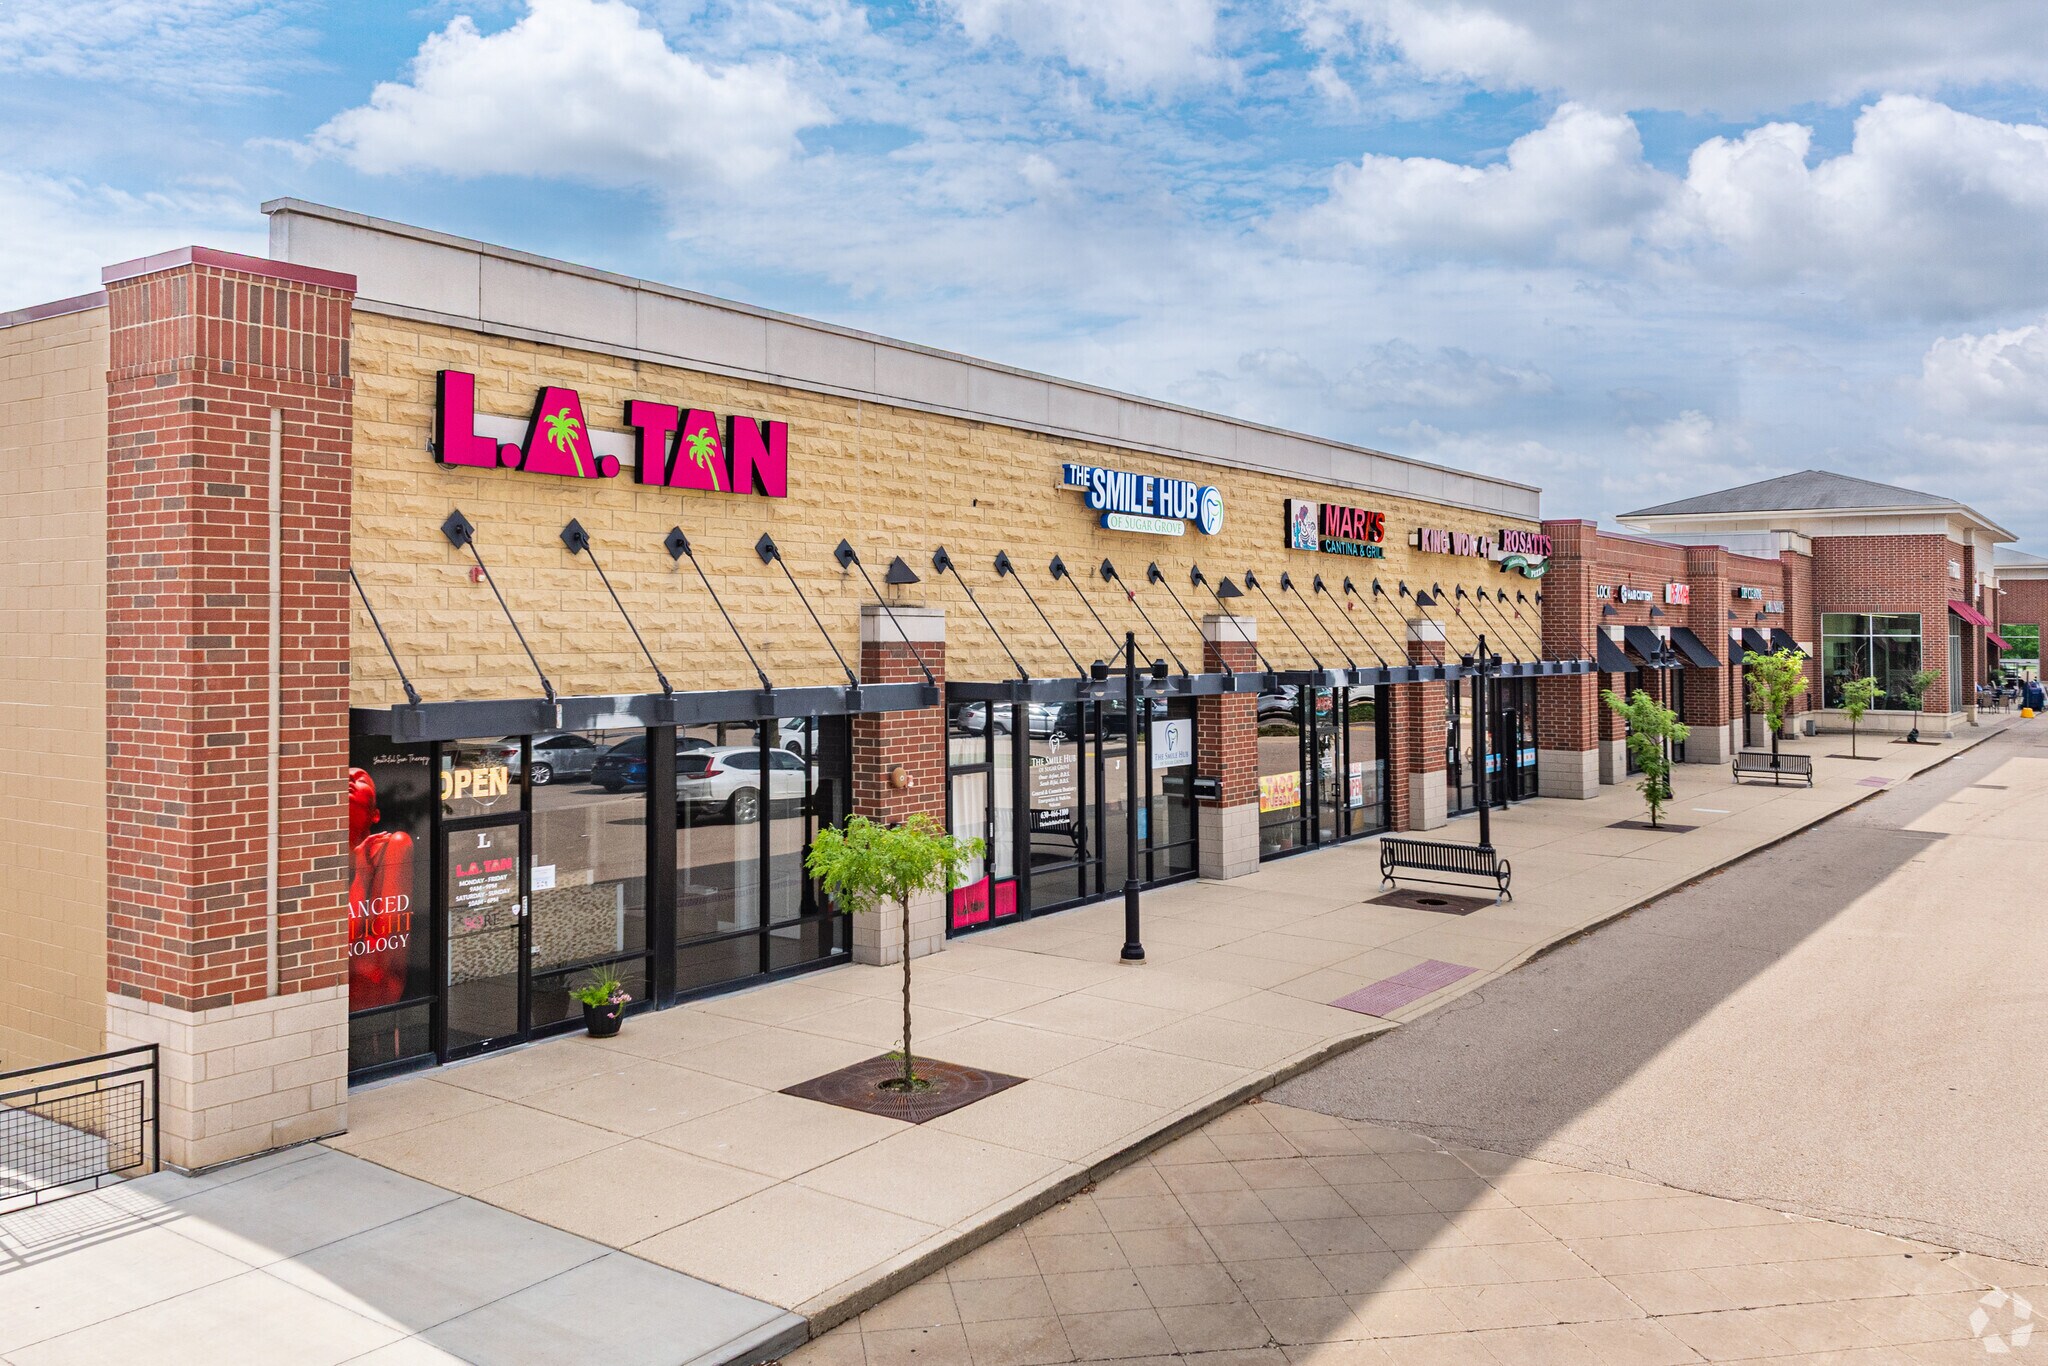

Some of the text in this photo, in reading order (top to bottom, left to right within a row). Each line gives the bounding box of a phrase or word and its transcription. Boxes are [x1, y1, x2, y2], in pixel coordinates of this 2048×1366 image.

[437, 370, 788, 498] L.A. TAN
[1069, 464, 1198, 520] THE SMILE HUB
[1110, 514, 1182, 534] OF SUGAR GROVE
[1325, 503, 1386, 543] MARI'S
[1325, 539, 1359, 556] CANTINA
[1359, 545, 1366, 557] &
[1420, 527, 1449, 554] KING
[1452, 531, 1478, 558] WOK
[1503, 530, 1552, 557] ROSATI'S
[1596, 584, 1611, 599] LOCK
[1031, 754, 1077, 767] THE SMILE HUB
[1154, 753, 1164, 761] THE
[1165, 752, 1178, 760] SMILE
[441, 766, 508, 801] OPEN
[477, 832, 491, 848] L
[483, 857, 513, 873] TAN
[458, 877, 485, 887] MONDAY
[487, 873, 508, 883] FRIDAY
[455, 891, 486, 902] SATURDAY
[488, 887, 511, 897] SUNDAY
[348, 894, 410, 919] ANCED
[351, 911, 414, 940] LIGHT
[348, 933, 409, 957] NOLOGY
